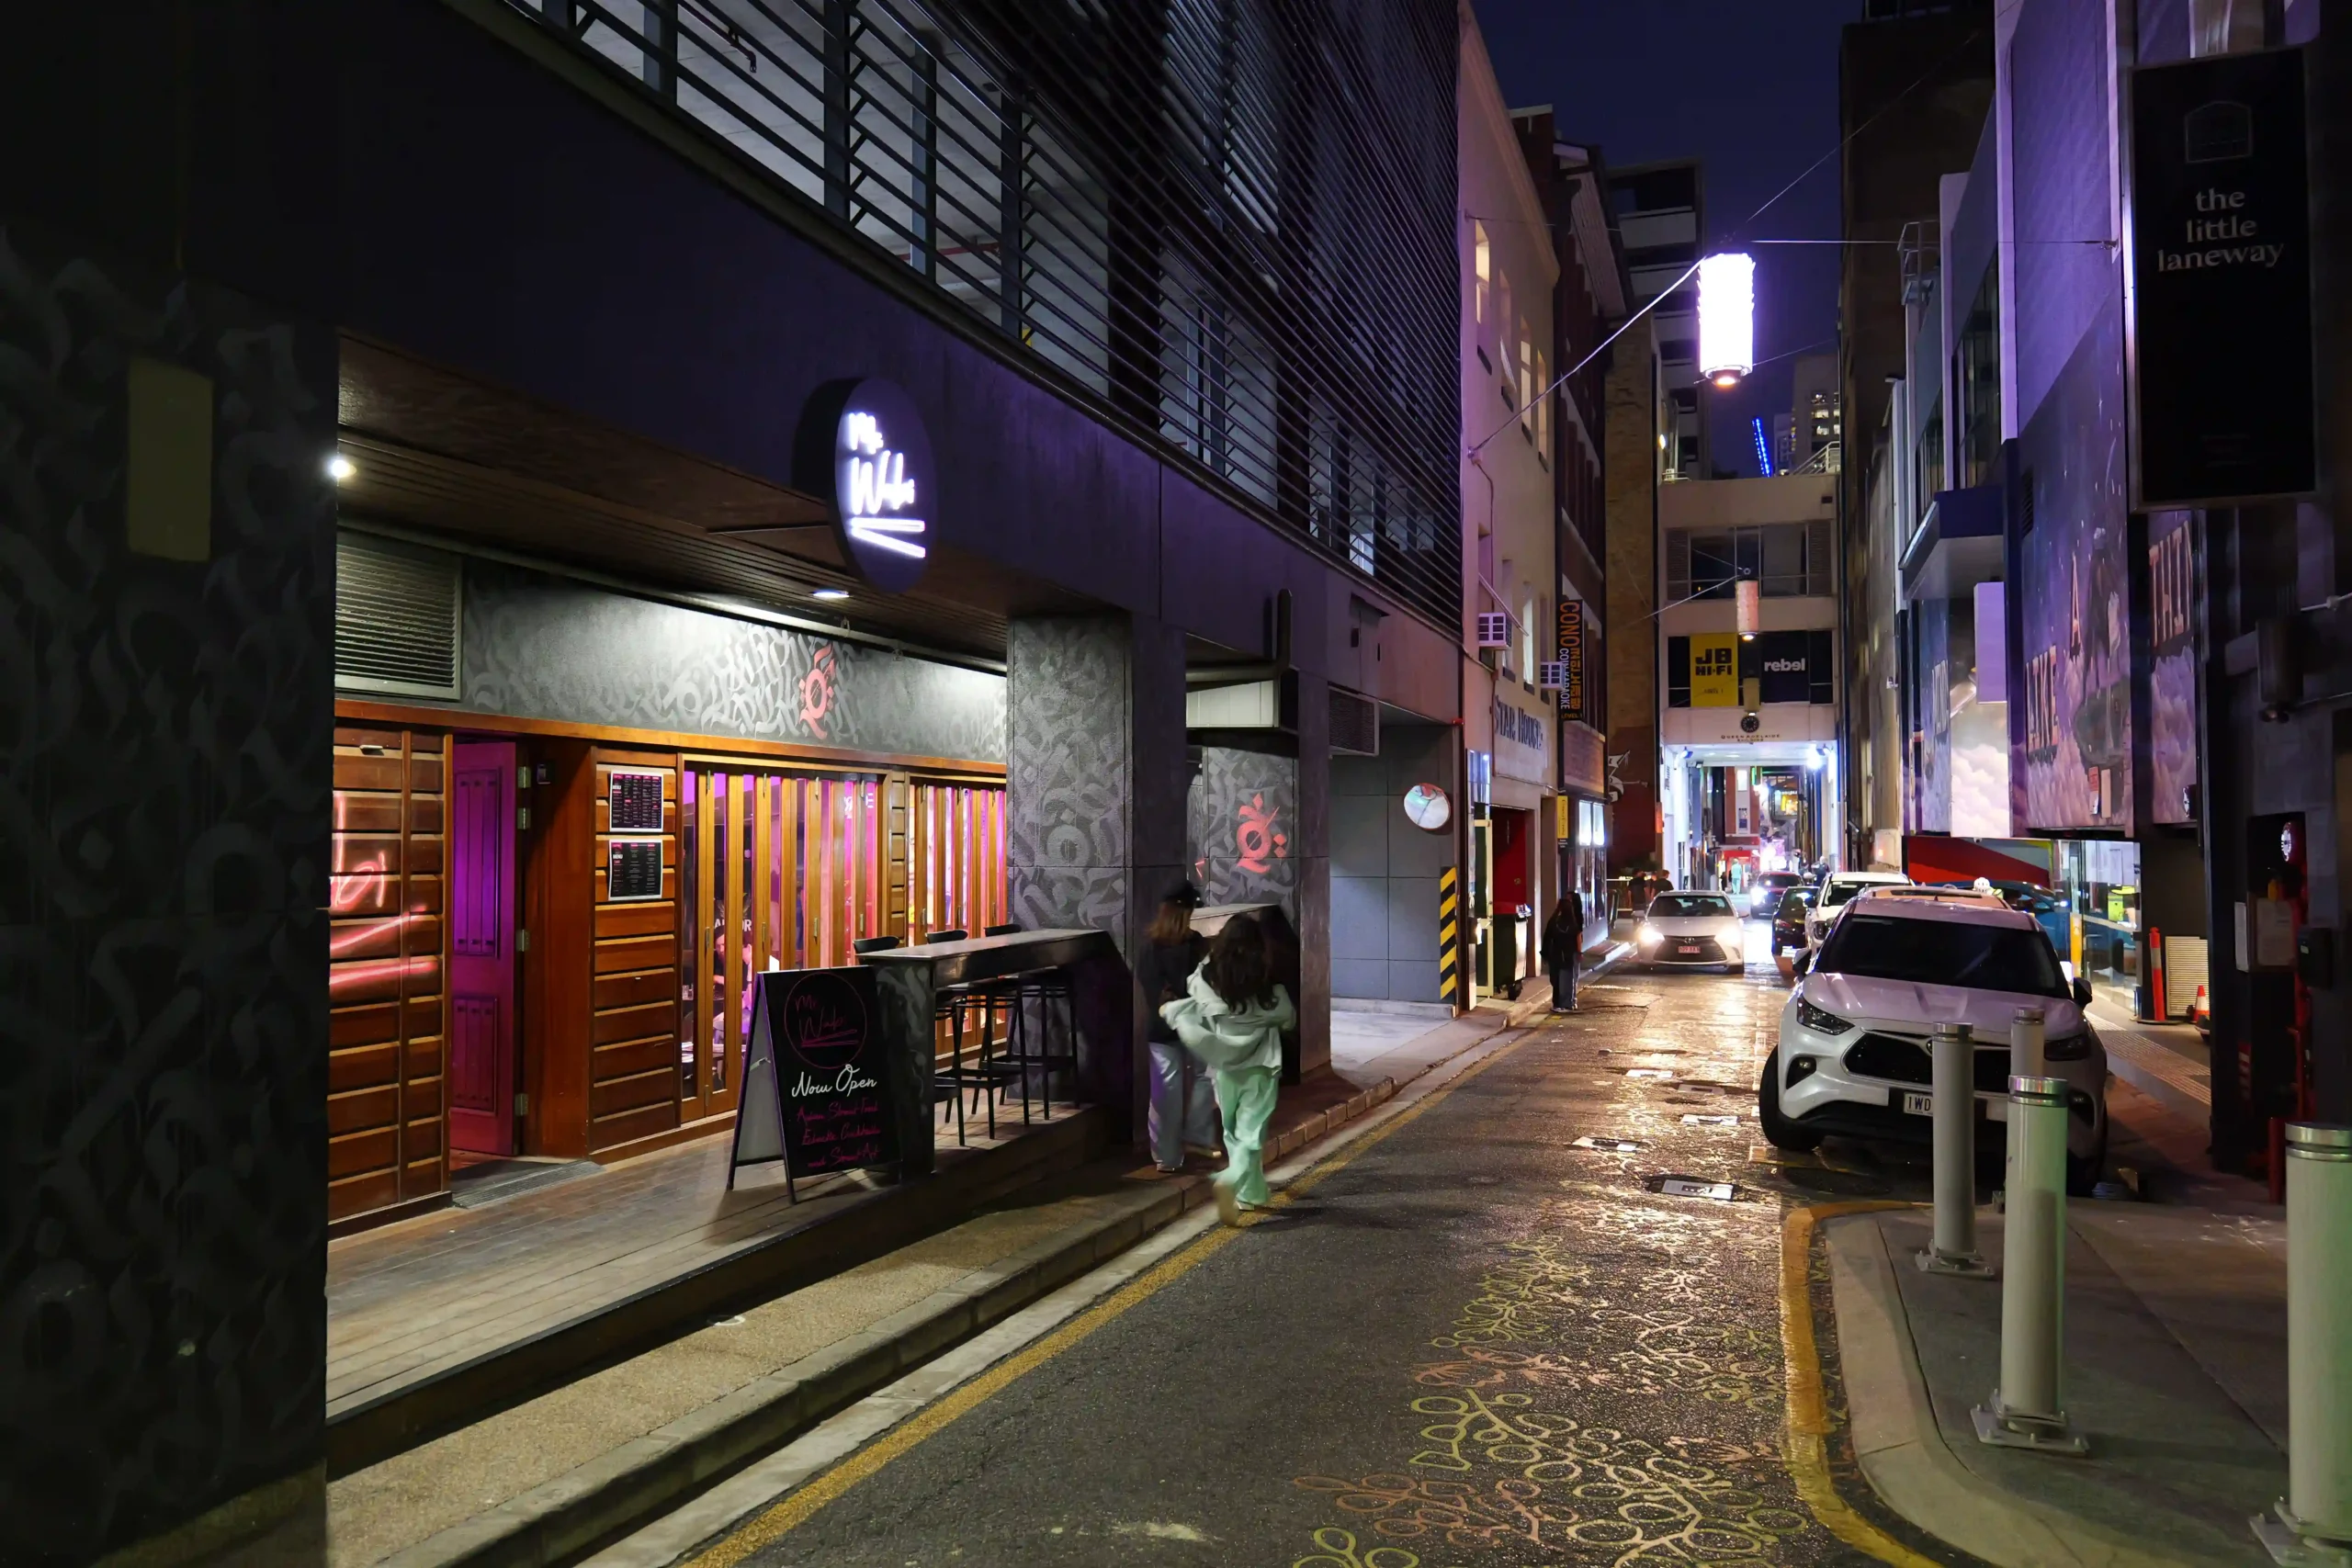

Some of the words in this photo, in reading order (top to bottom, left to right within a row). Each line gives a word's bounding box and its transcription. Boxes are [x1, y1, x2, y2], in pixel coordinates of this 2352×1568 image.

[2195, 187, 2245, 212] the
[2186, 215, 2257, 243] little
[2156, 243, 2285, 273] laneway
[1559, 602, 1580, 647] CONO
[1695, 648, 1733, 665] JB
[1764, 658, 1805, 671] rebel
[792, 1071, 832, 1098] Now
[834, 1064, 877, 1097] Open
